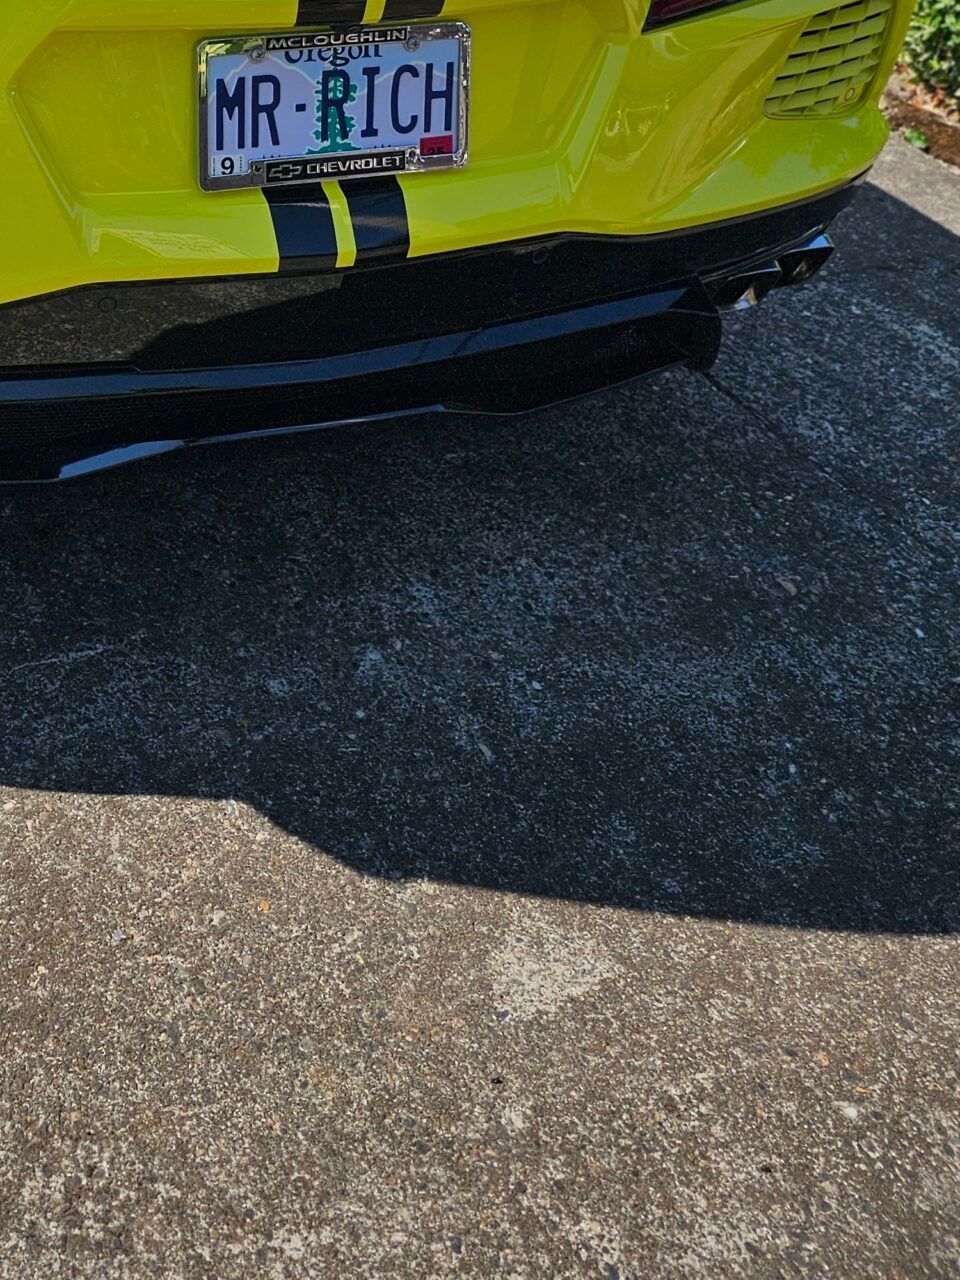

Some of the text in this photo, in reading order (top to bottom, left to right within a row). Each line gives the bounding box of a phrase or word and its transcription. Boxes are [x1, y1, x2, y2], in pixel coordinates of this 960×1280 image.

[268, 30, 406, 49] MCLOUGHLIN
[216, 61, 455, 151] MR-RICH
[221, 157, 235, 175] 9
[307, 156, 403, 174] CHEVROLET
